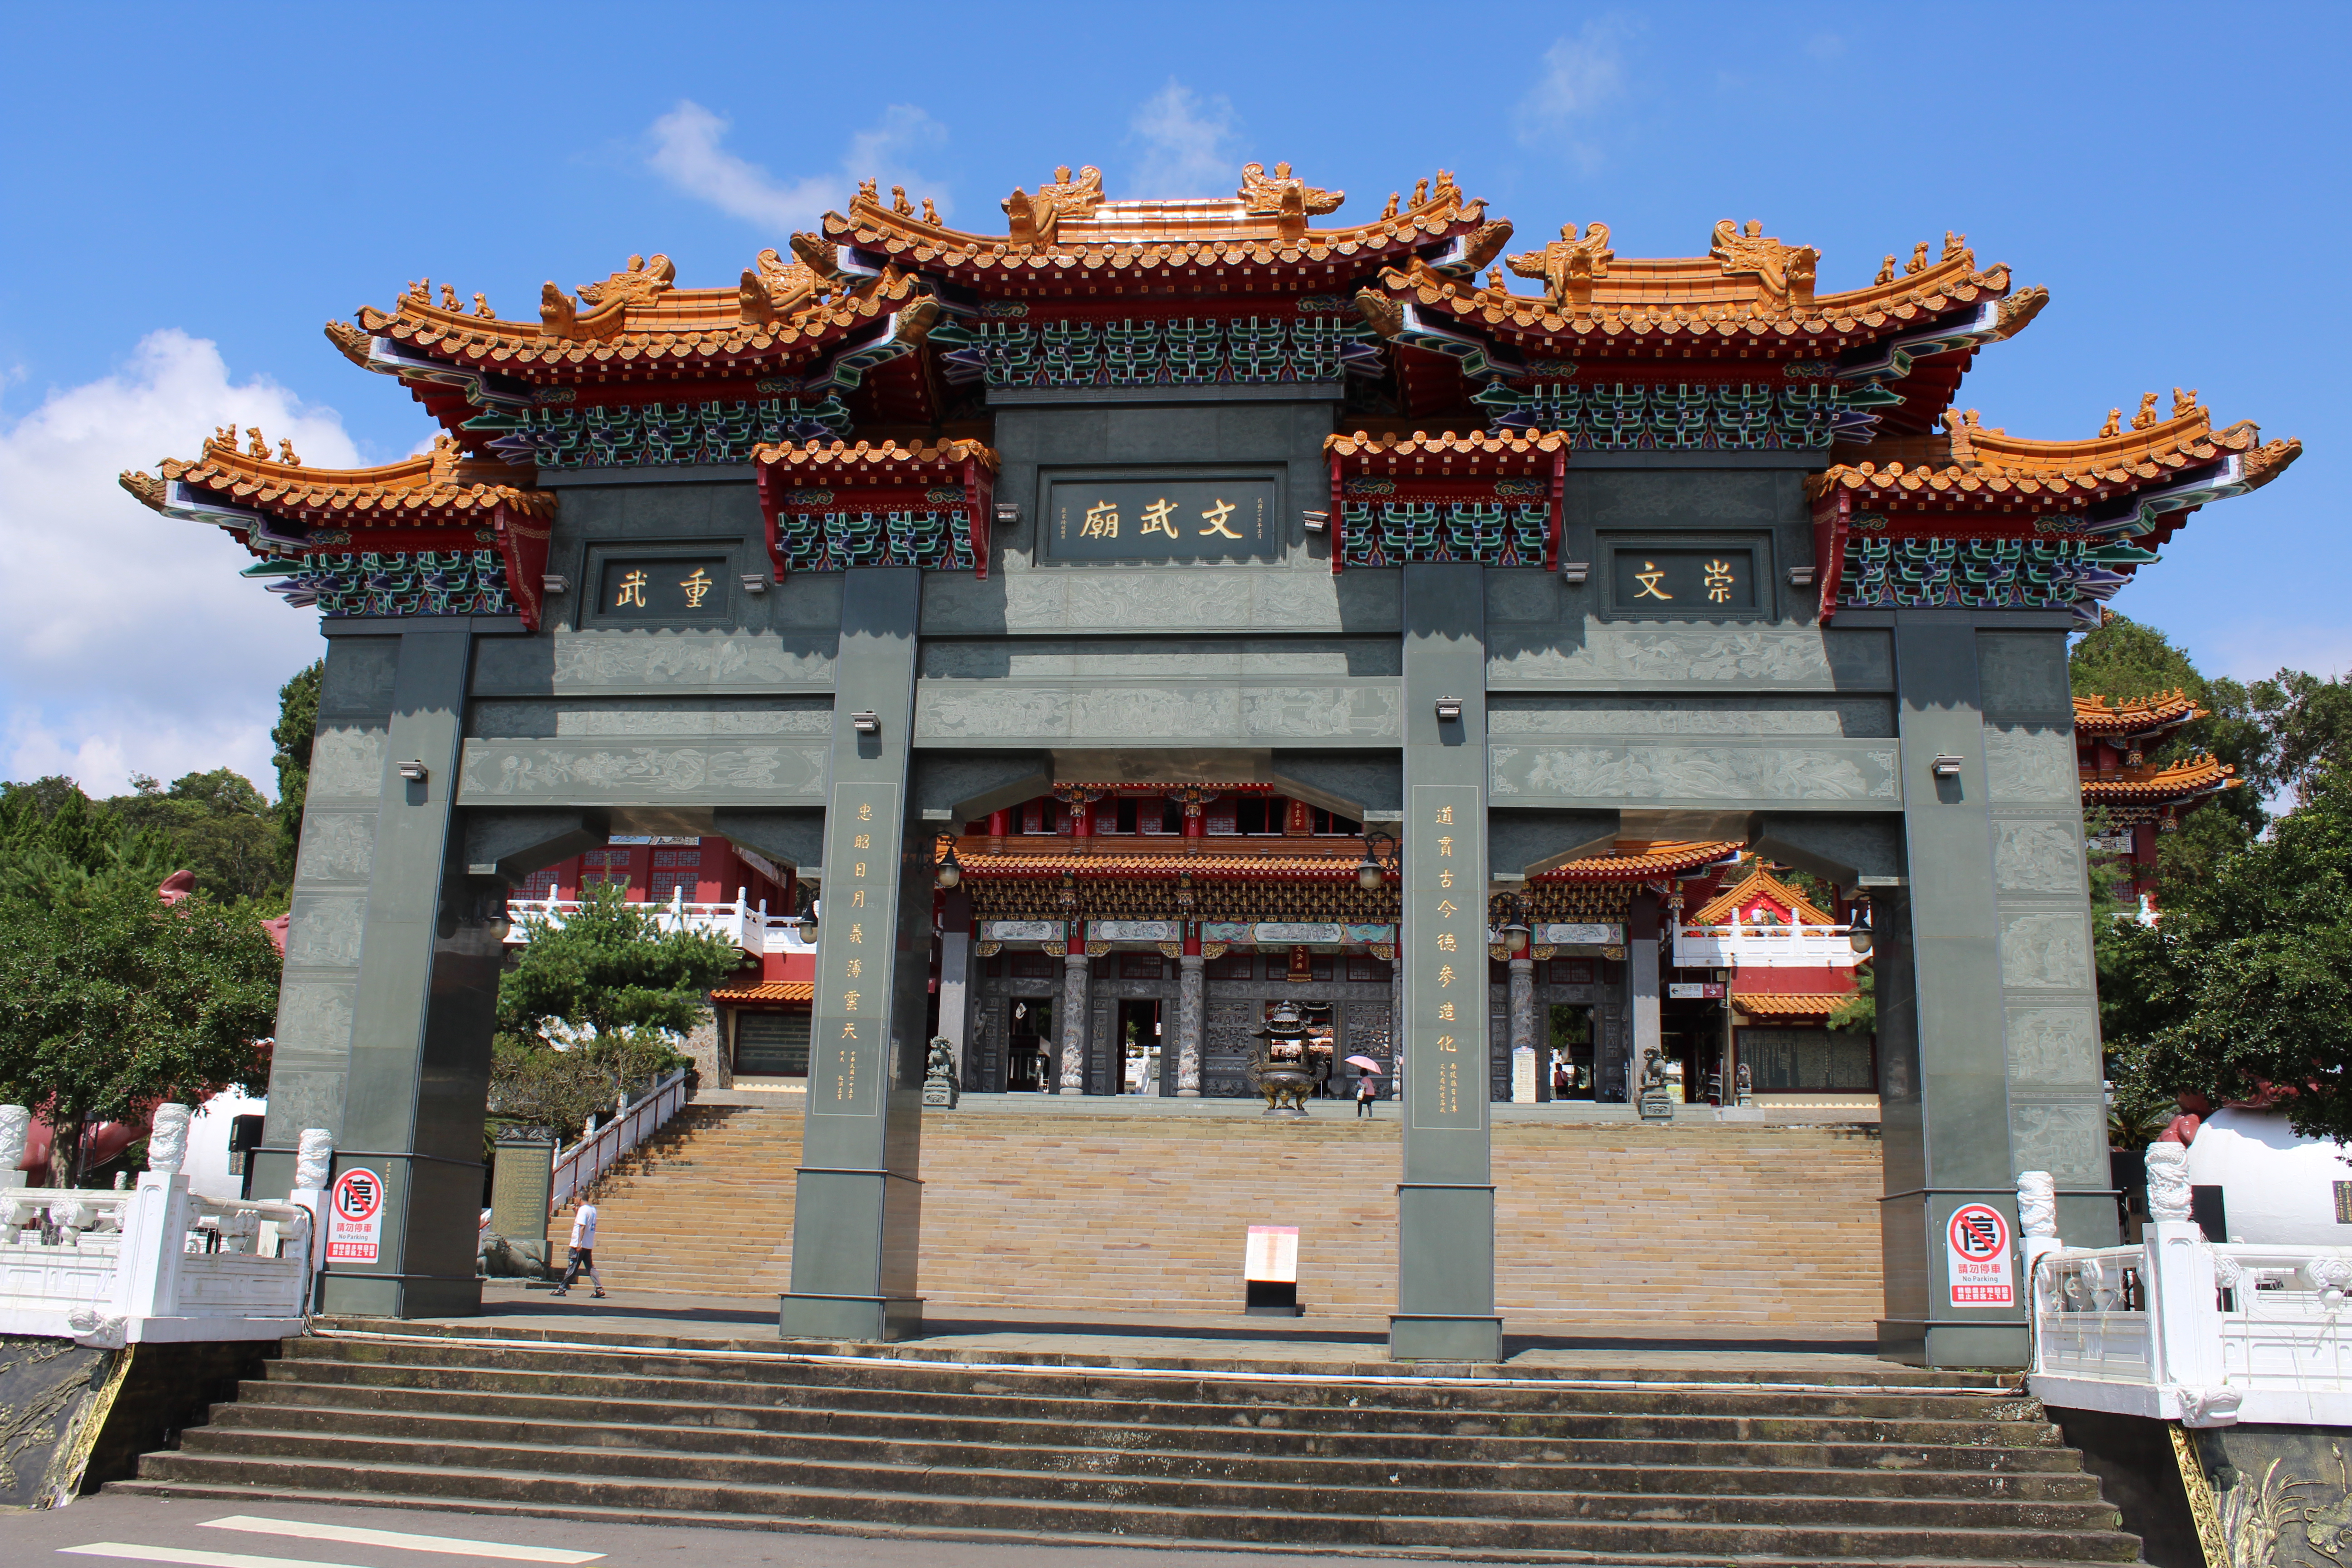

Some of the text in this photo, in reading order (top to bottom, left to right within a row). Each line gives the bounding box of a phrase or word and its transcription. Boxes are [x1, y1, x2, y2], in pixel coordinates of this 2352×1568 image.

[1079, 498, 1243, 539] 文武廟
[615, 567, 713, 608] 重武
[1633, 559, 1735, 603] 崇文
[841, 803, 872, 1040] 忠昭日月義薄雲天
[1295, 945, 1303, 969] 文武廟
[336, 1222, 372, 1233] 請勿停車
[1958, 1264, 2001, 1274] 請勿停車
